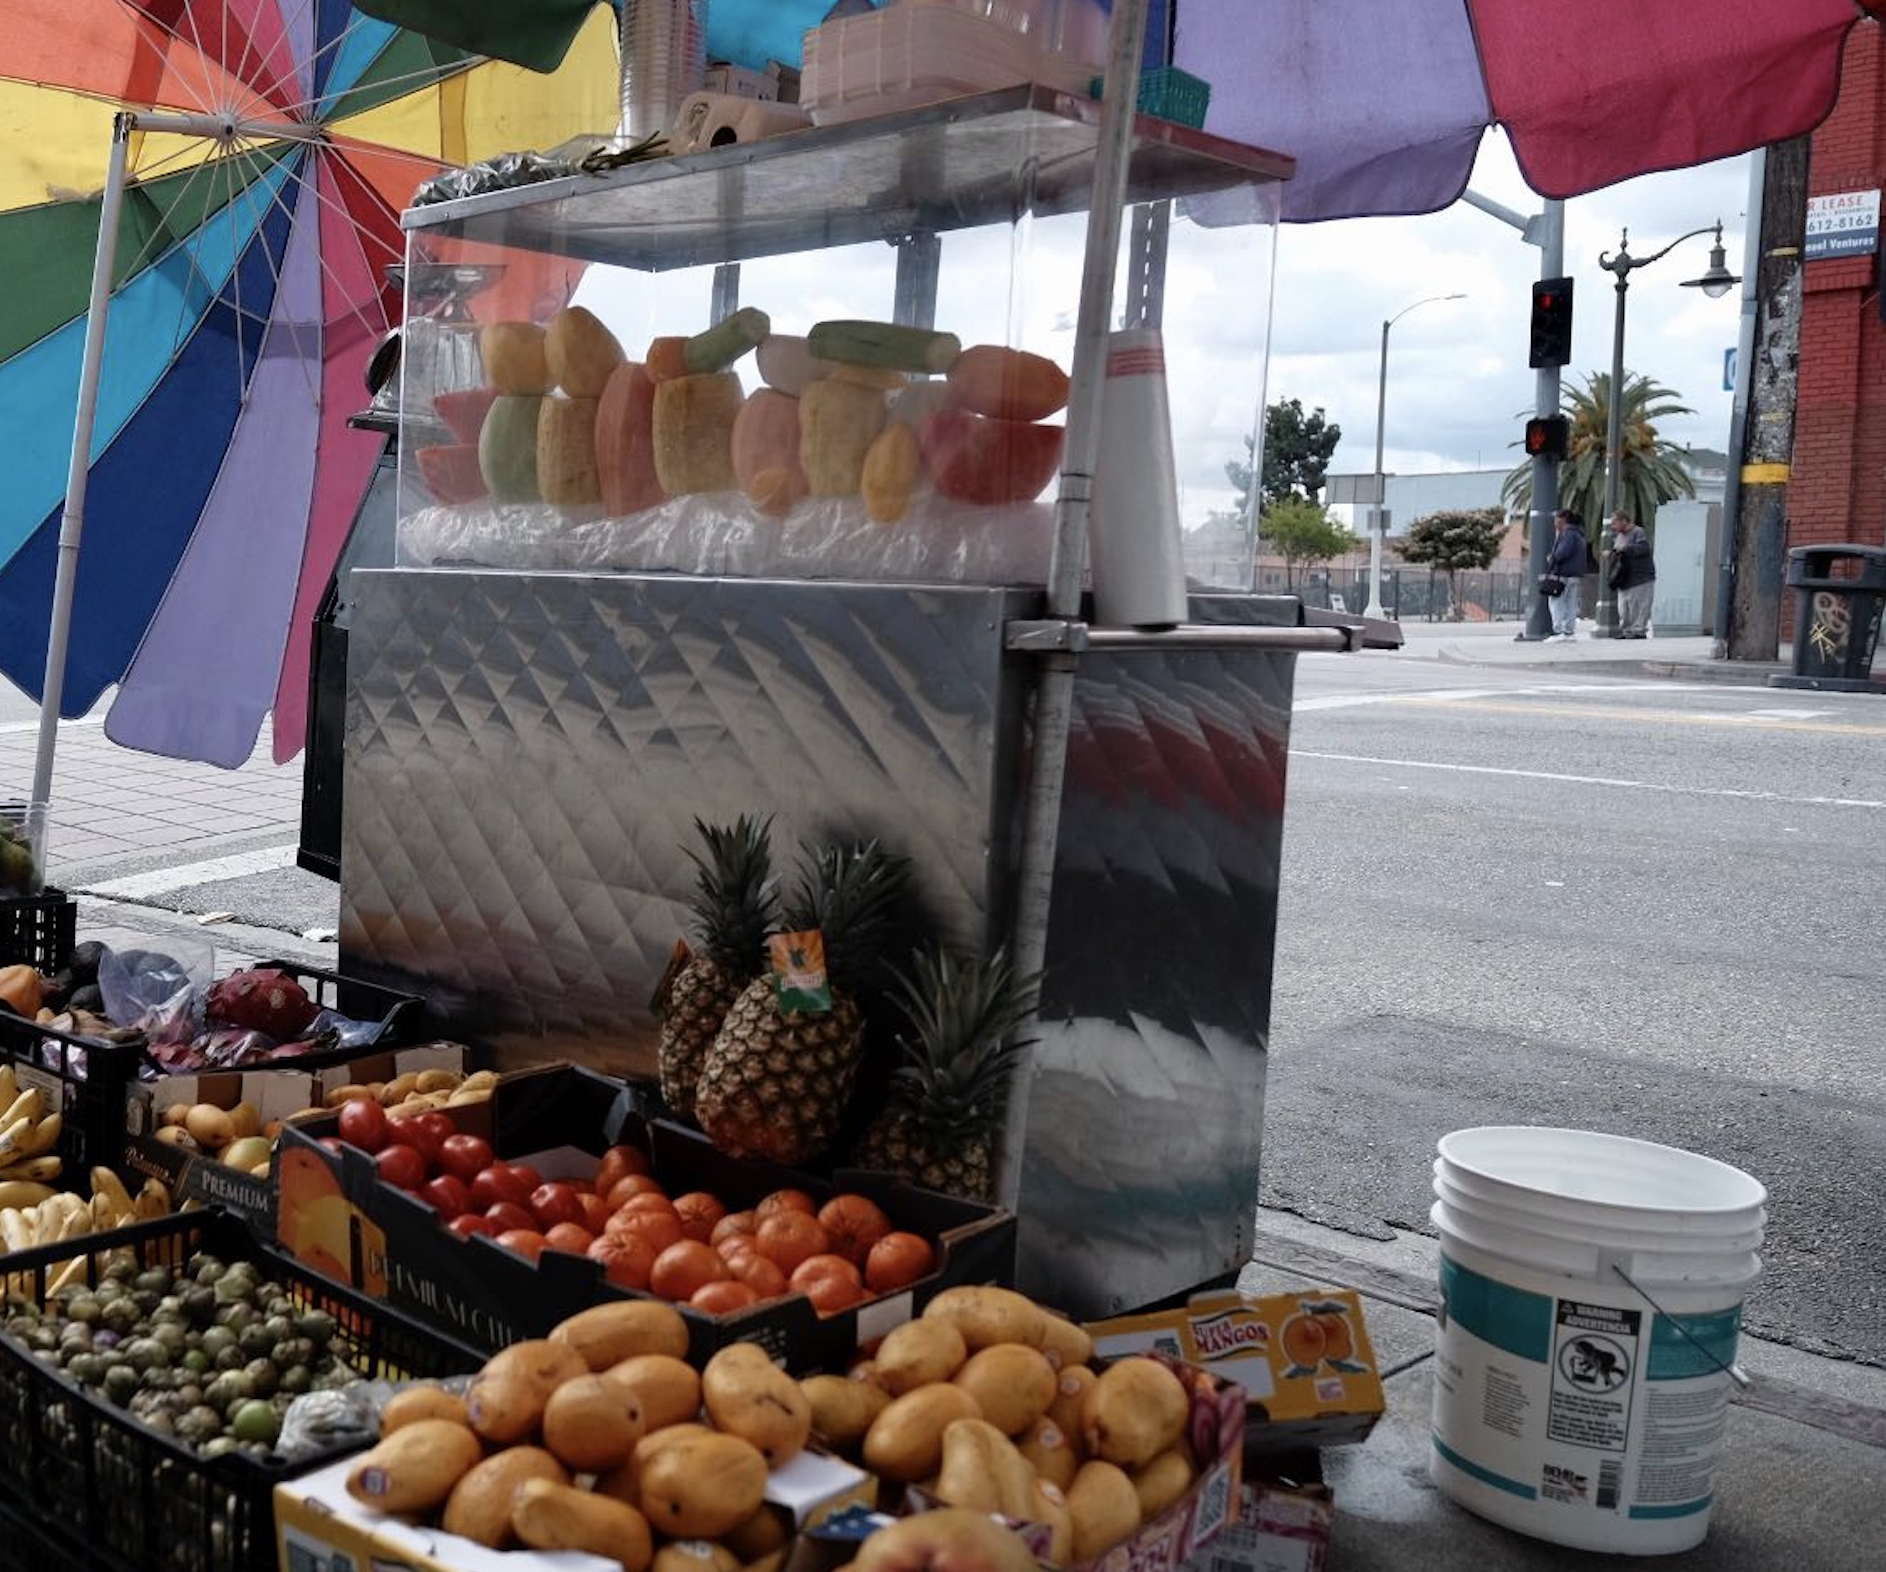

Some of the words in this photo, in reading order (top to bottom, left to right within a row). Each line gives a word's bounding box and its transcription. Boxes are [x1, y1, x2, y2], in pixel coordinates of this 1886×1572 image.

[1822, 195, 1864, 210] LEASE
[1830, 236, 1875, 250] Ventures
[201, 1169, 270, 1213] PREMIUM
[1196, 1325, 1269, 1353] MANGOS
